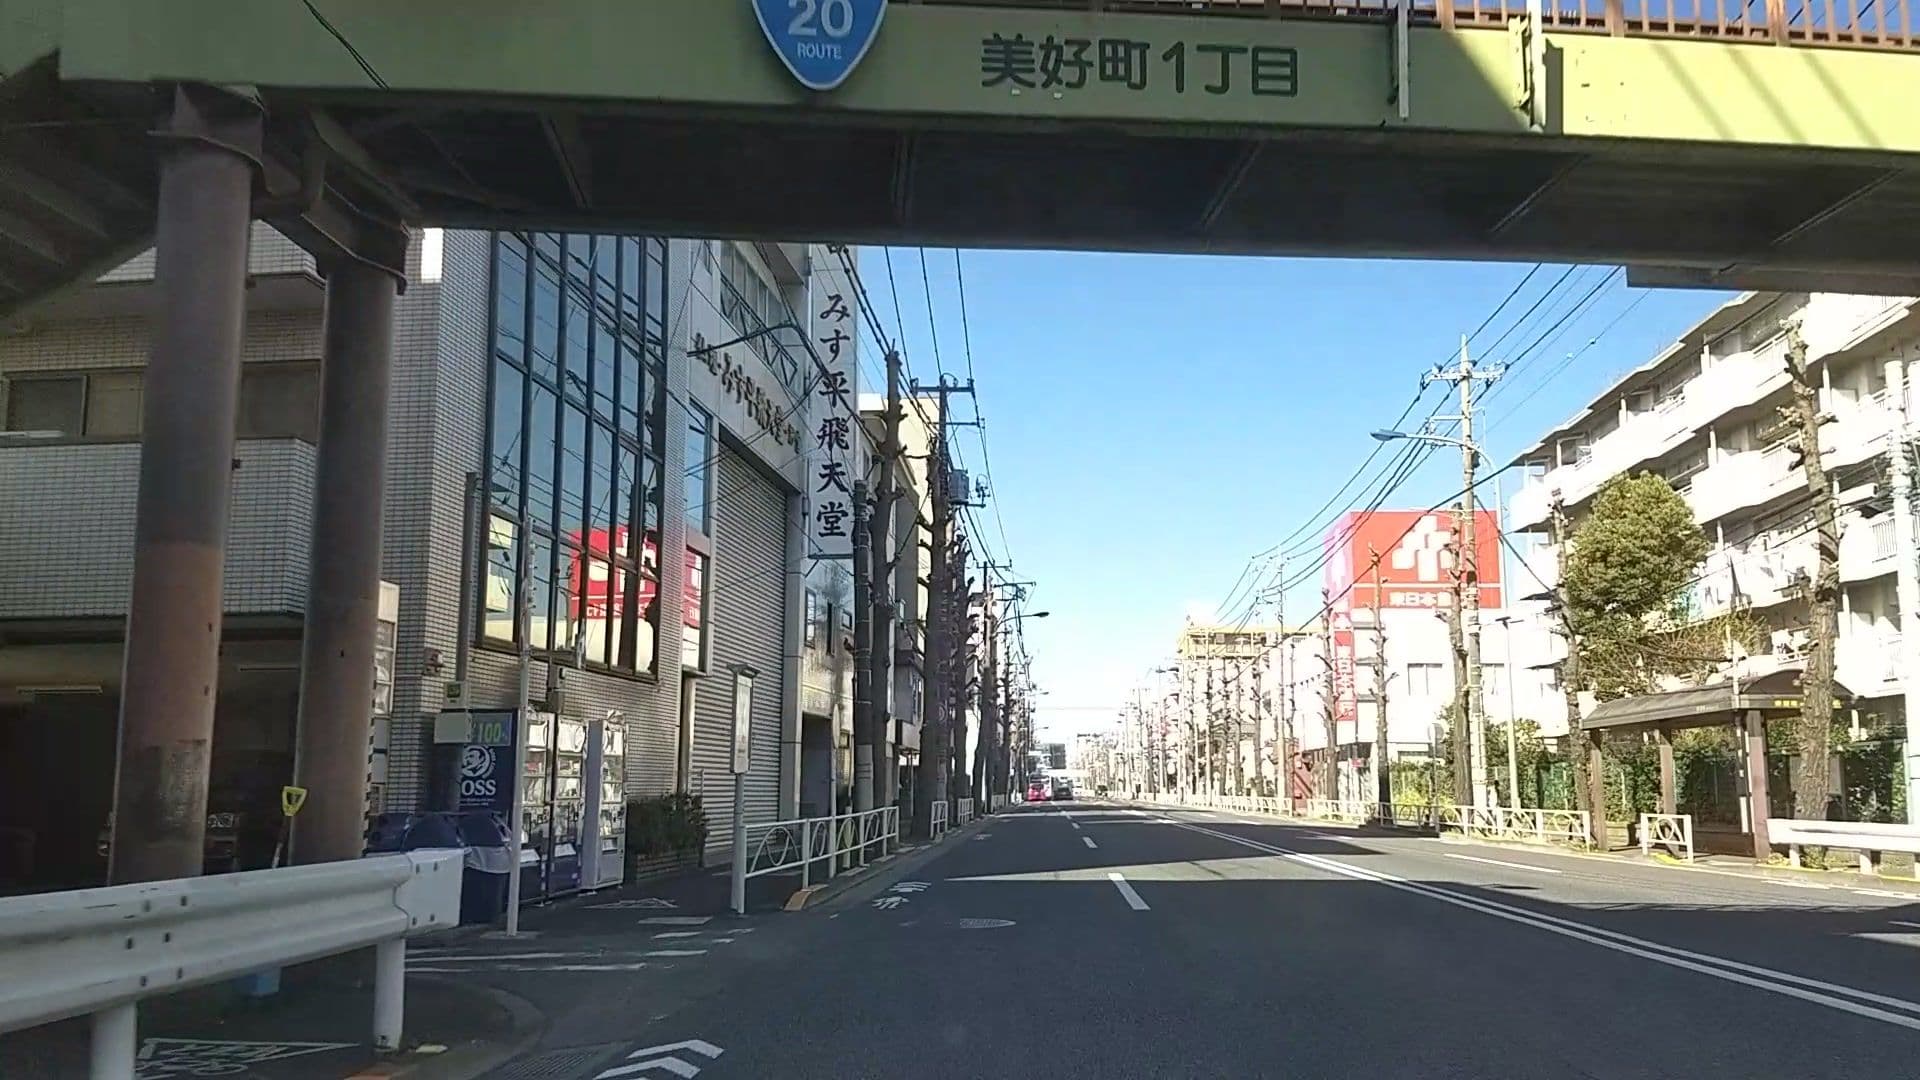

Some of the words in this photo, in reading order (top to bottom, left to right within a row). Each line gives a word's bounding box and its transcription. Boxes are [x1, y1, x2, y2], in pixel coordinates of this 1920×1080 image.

[788, 0, 854, 37] 20
[797, 42, 841, 60] ROUTE
[981, 32, 1299, 98] 美好町1丁目
[815, 293, 851, 538] みす平飛天堂
[461, 779, 497, 796] OSS
